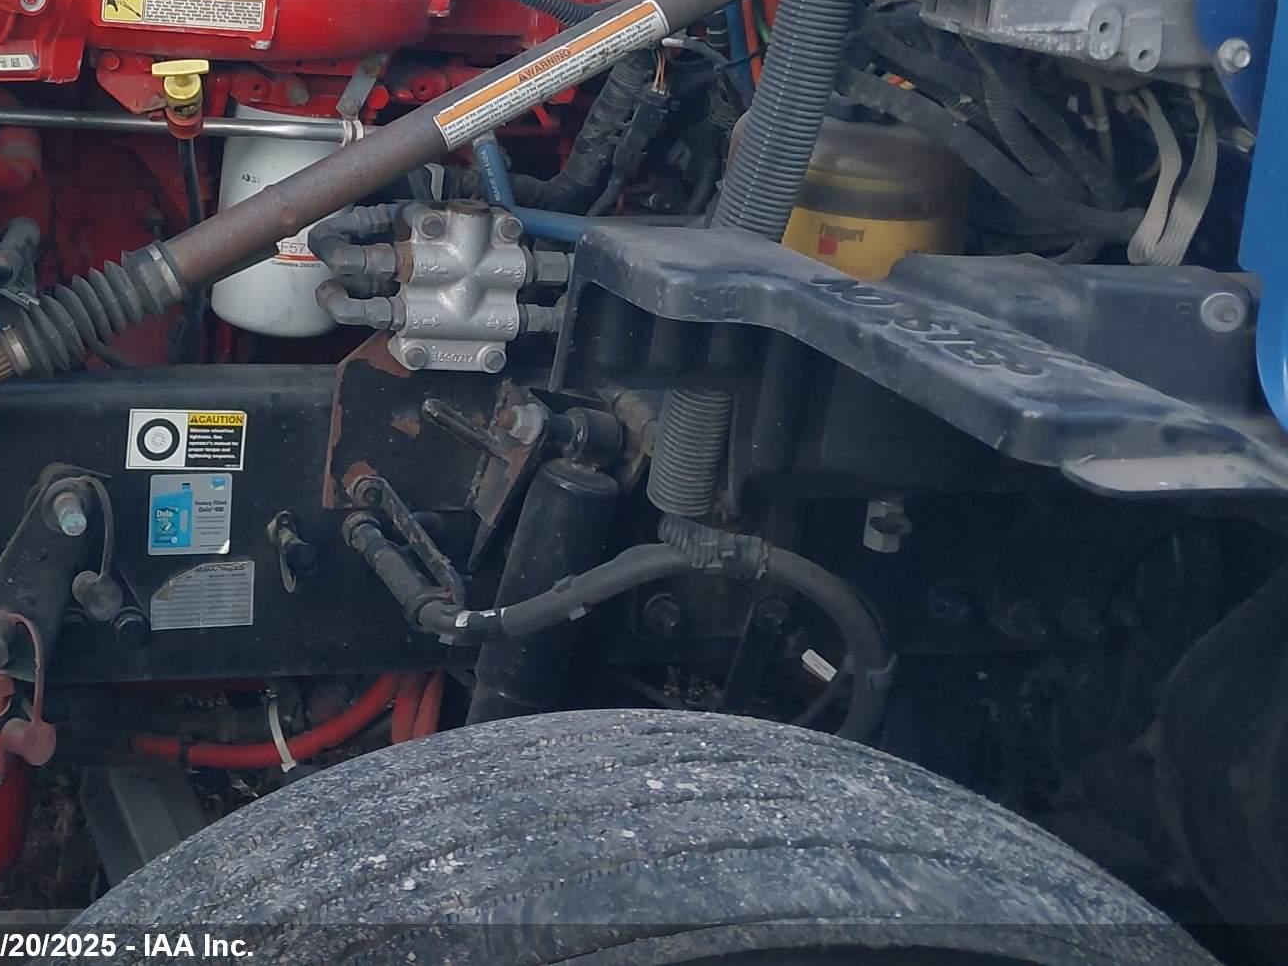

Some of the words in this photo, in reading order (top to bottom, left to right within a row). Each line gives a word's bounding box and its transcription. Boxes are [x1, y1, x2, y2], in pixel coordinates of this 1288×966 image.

[526, 48, 572, 79] WARNING
[199, 415, 243, 424] CAUTION
[156, 509, 174, 518] Delo
